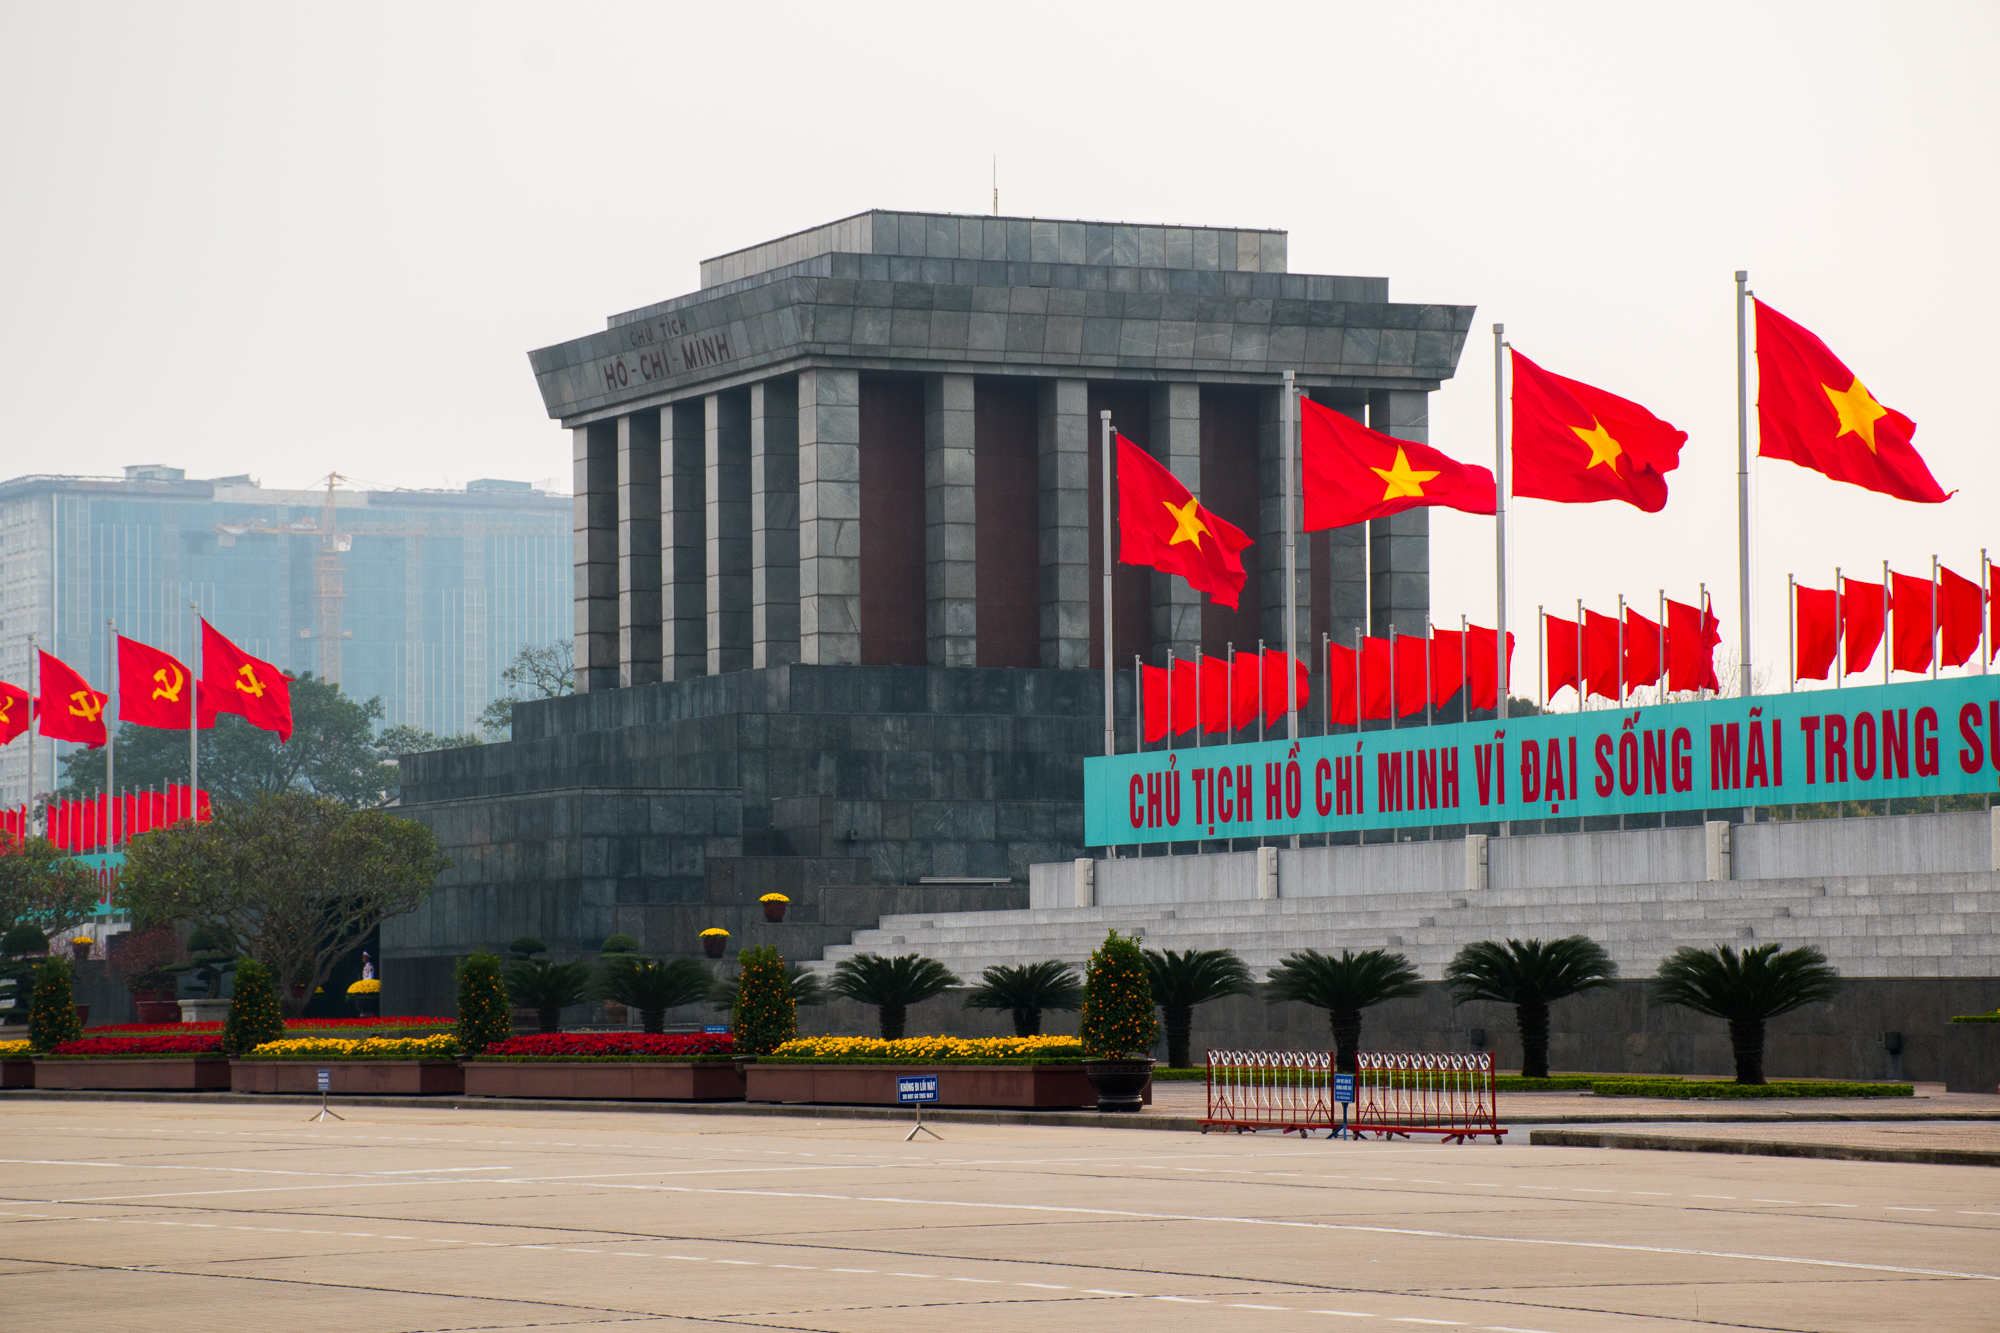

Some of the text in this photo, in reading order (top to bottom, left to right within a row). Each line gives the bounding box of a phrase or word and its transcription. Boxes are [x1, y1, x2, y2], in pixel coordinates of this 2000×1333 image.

[1129, 754, 1181, 829] CHỦ
[1192, 764, 1253, 836] TỊCH
[1266, 741, 1302, 821] HỒ
[1315, 741, 1364, 817] CHÍ
[1378, 746, 1460, 813] MINH
[1474, 729, 1506, 807] VĨ
[1521, 736, 1578, 814] ĐẠI
[1595, 711, 1693, 798] SỐNG
[1711, 706, 1782, 790] MÃI
[1801, 706, 1939, 785] TRONG
